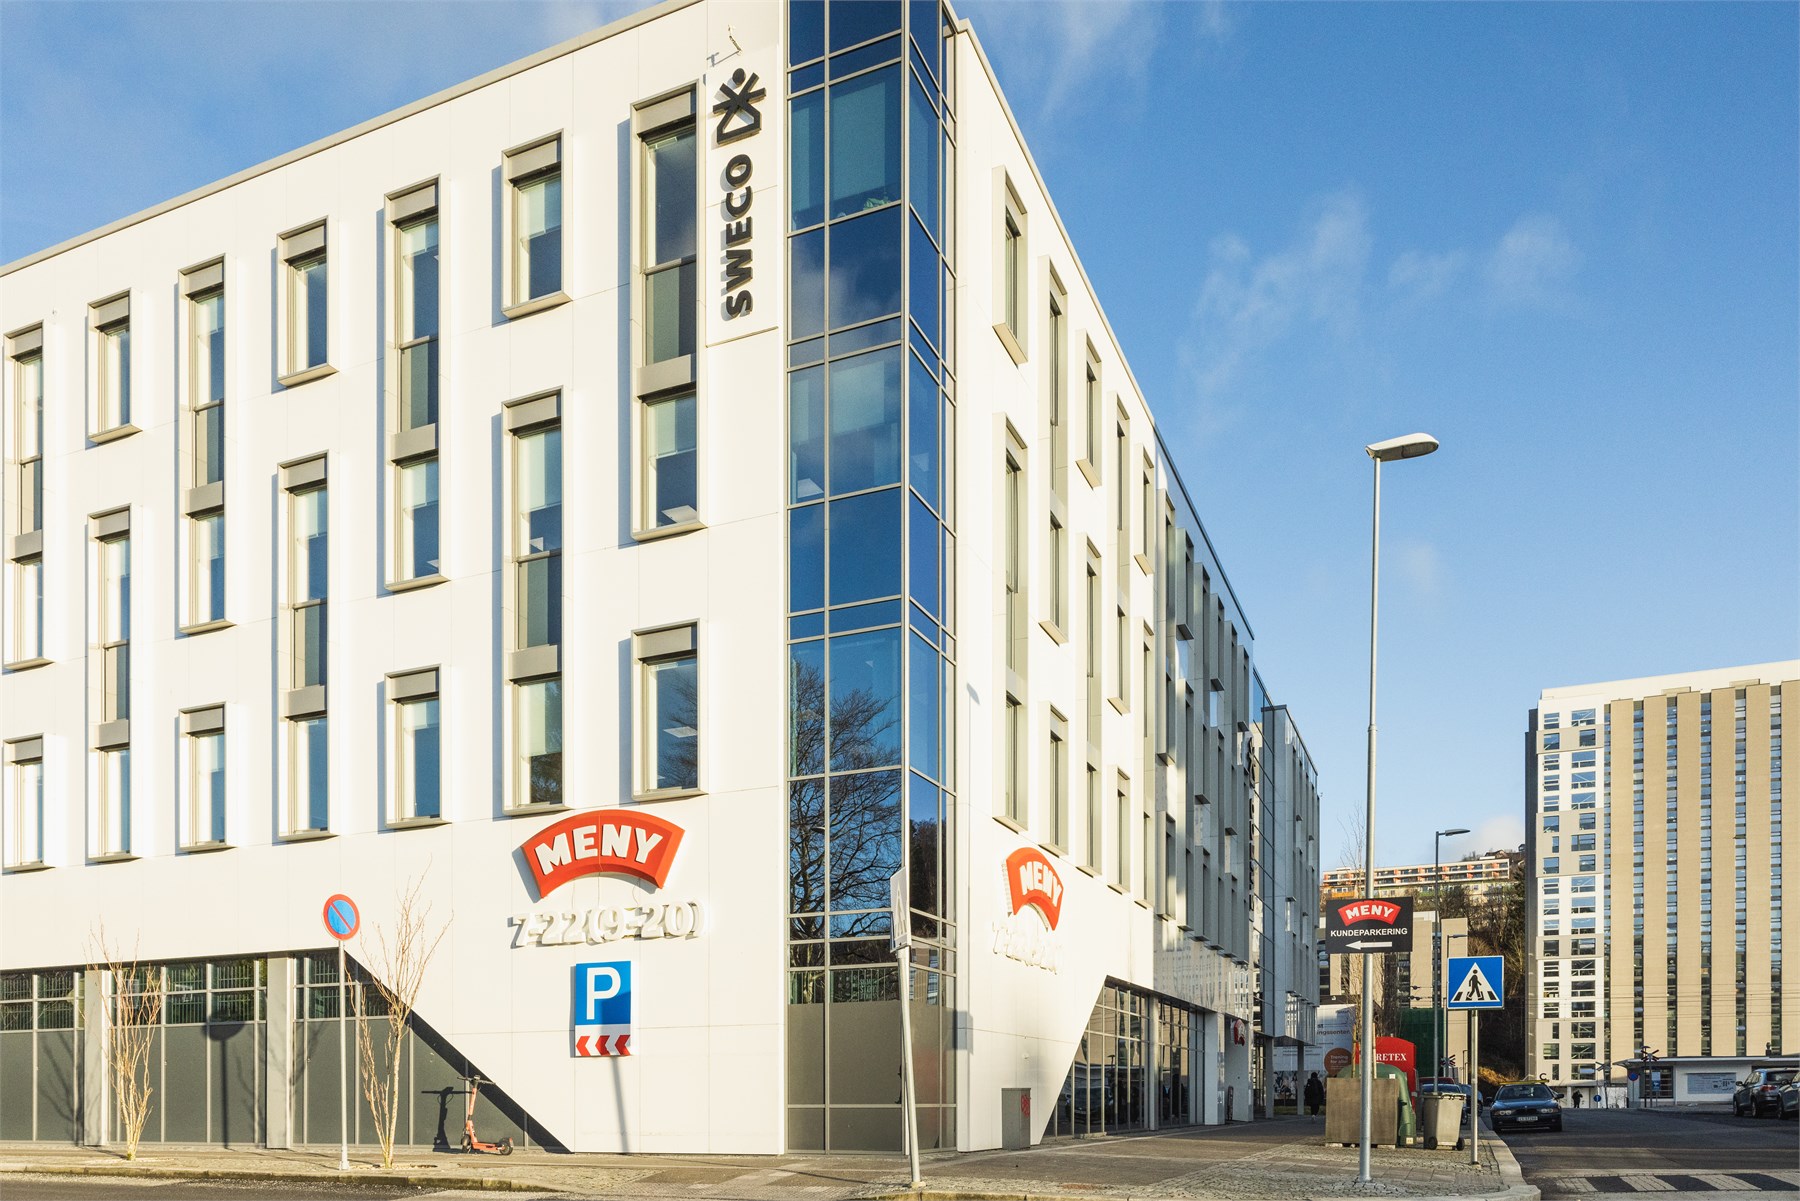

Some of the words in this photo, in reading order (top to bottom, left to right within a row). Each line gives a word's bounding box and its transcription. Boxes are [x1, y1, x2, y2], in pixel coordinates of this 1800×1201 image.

[725, 153, 753, 318] SWECO
[534, 823, 663, 876] MENY
[1019, 860, 1063, 907] MENY
[1330, 927, 1408, 938] KUNDEPARKERING
[1345, 904, 1394, 920] MENY
[586, 966, 621, 1020] P
[1376, 1053, 1407, 1061] RETEX
